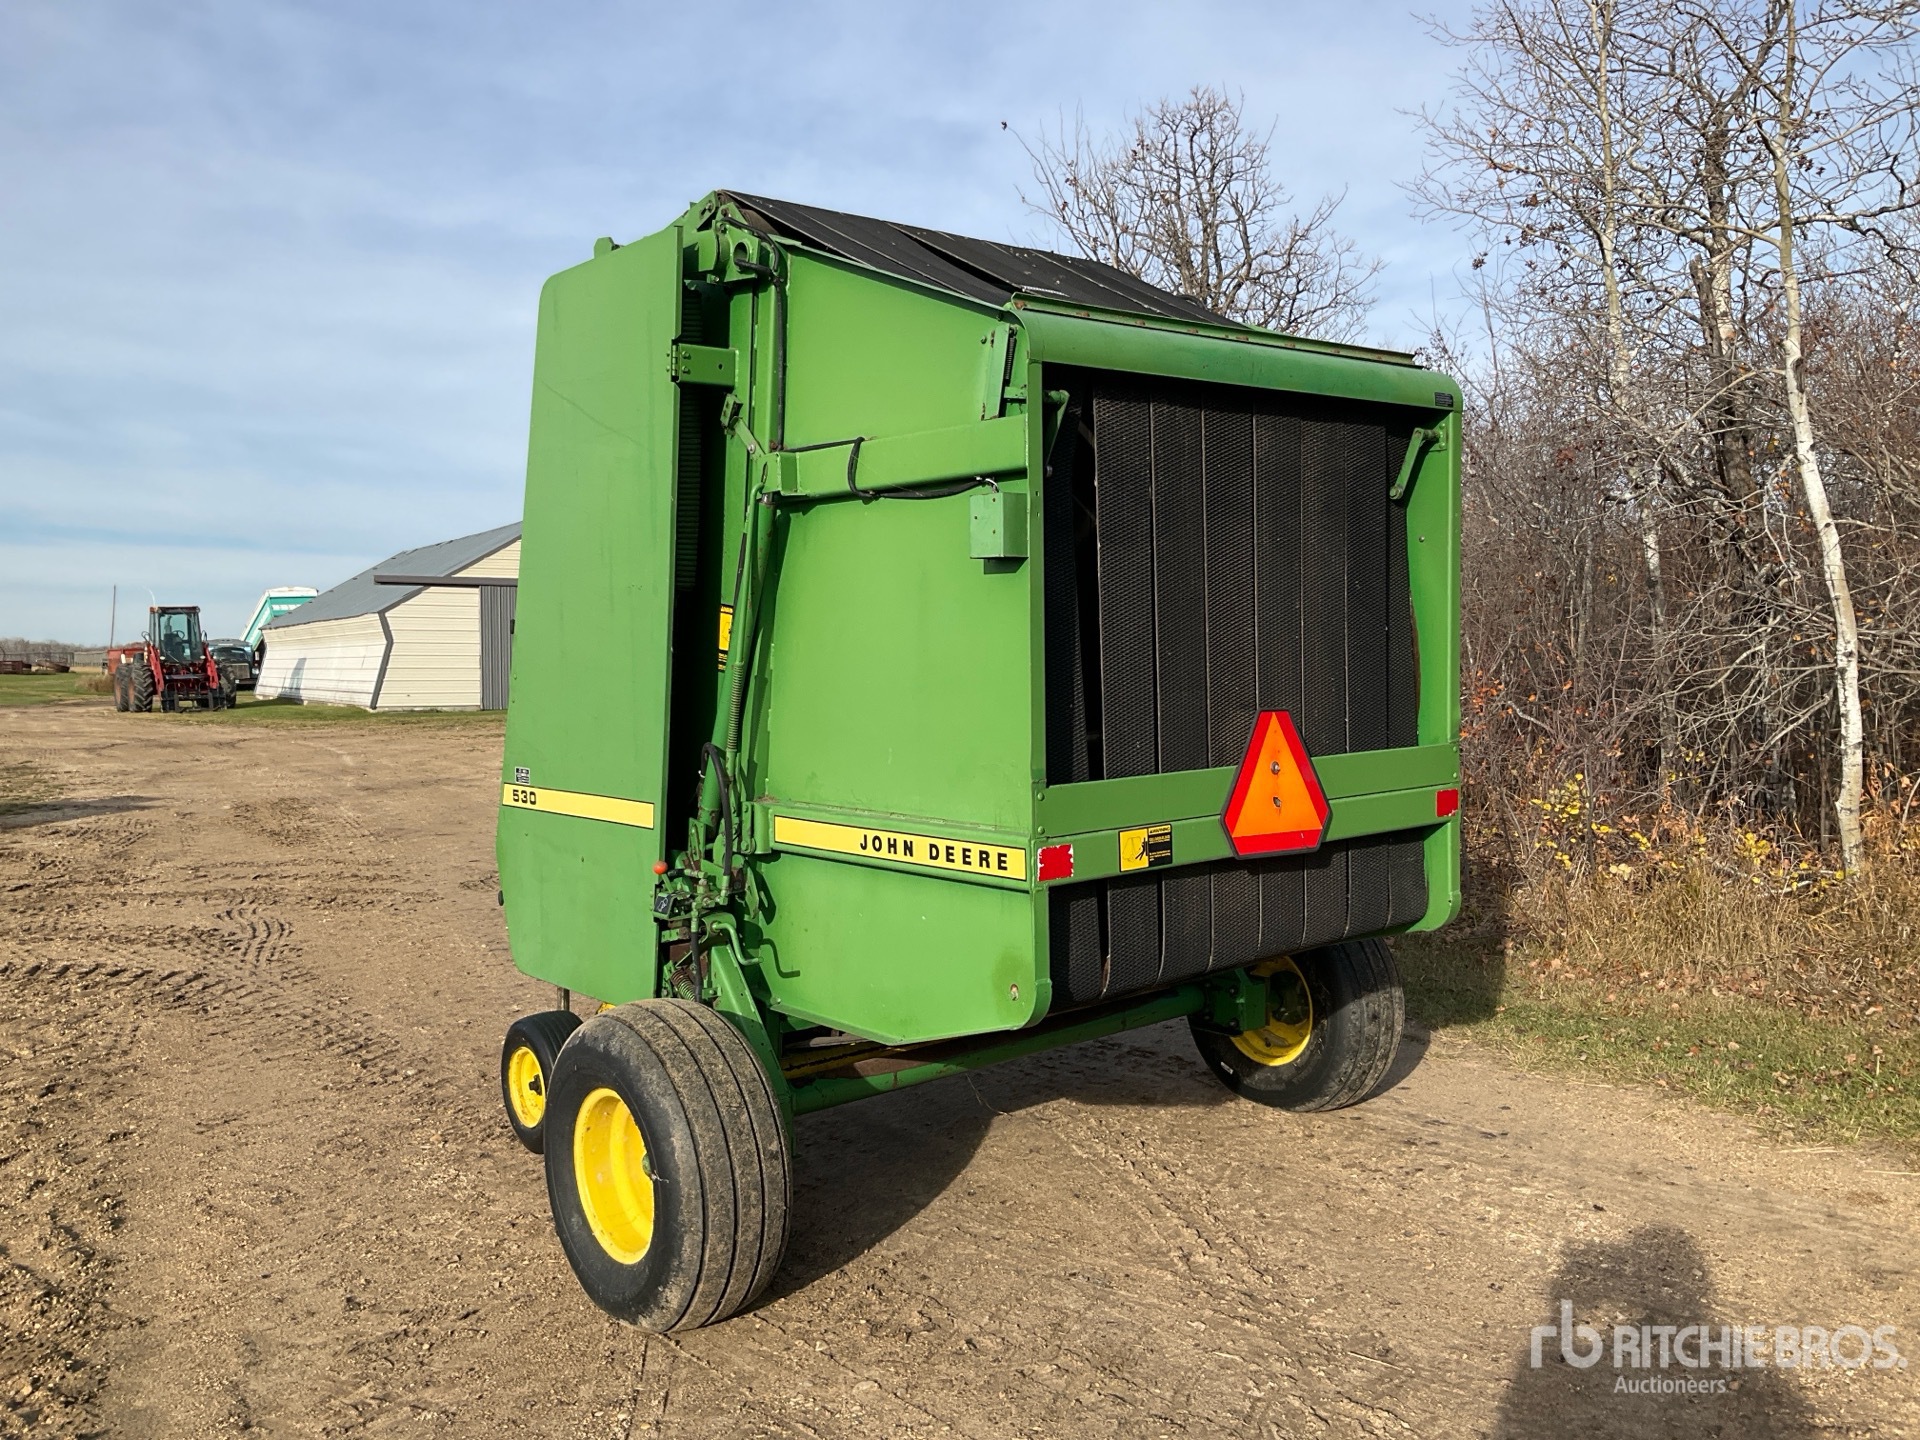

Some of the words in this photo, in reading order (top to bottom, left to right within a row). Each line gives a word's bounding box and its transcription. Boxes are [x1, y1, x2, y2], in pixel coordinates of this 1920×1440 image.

[512, 789, 536, 805] 530
[860, 834, 914, 857] JOHN
[929, 843, 1008, 871] DEERE
